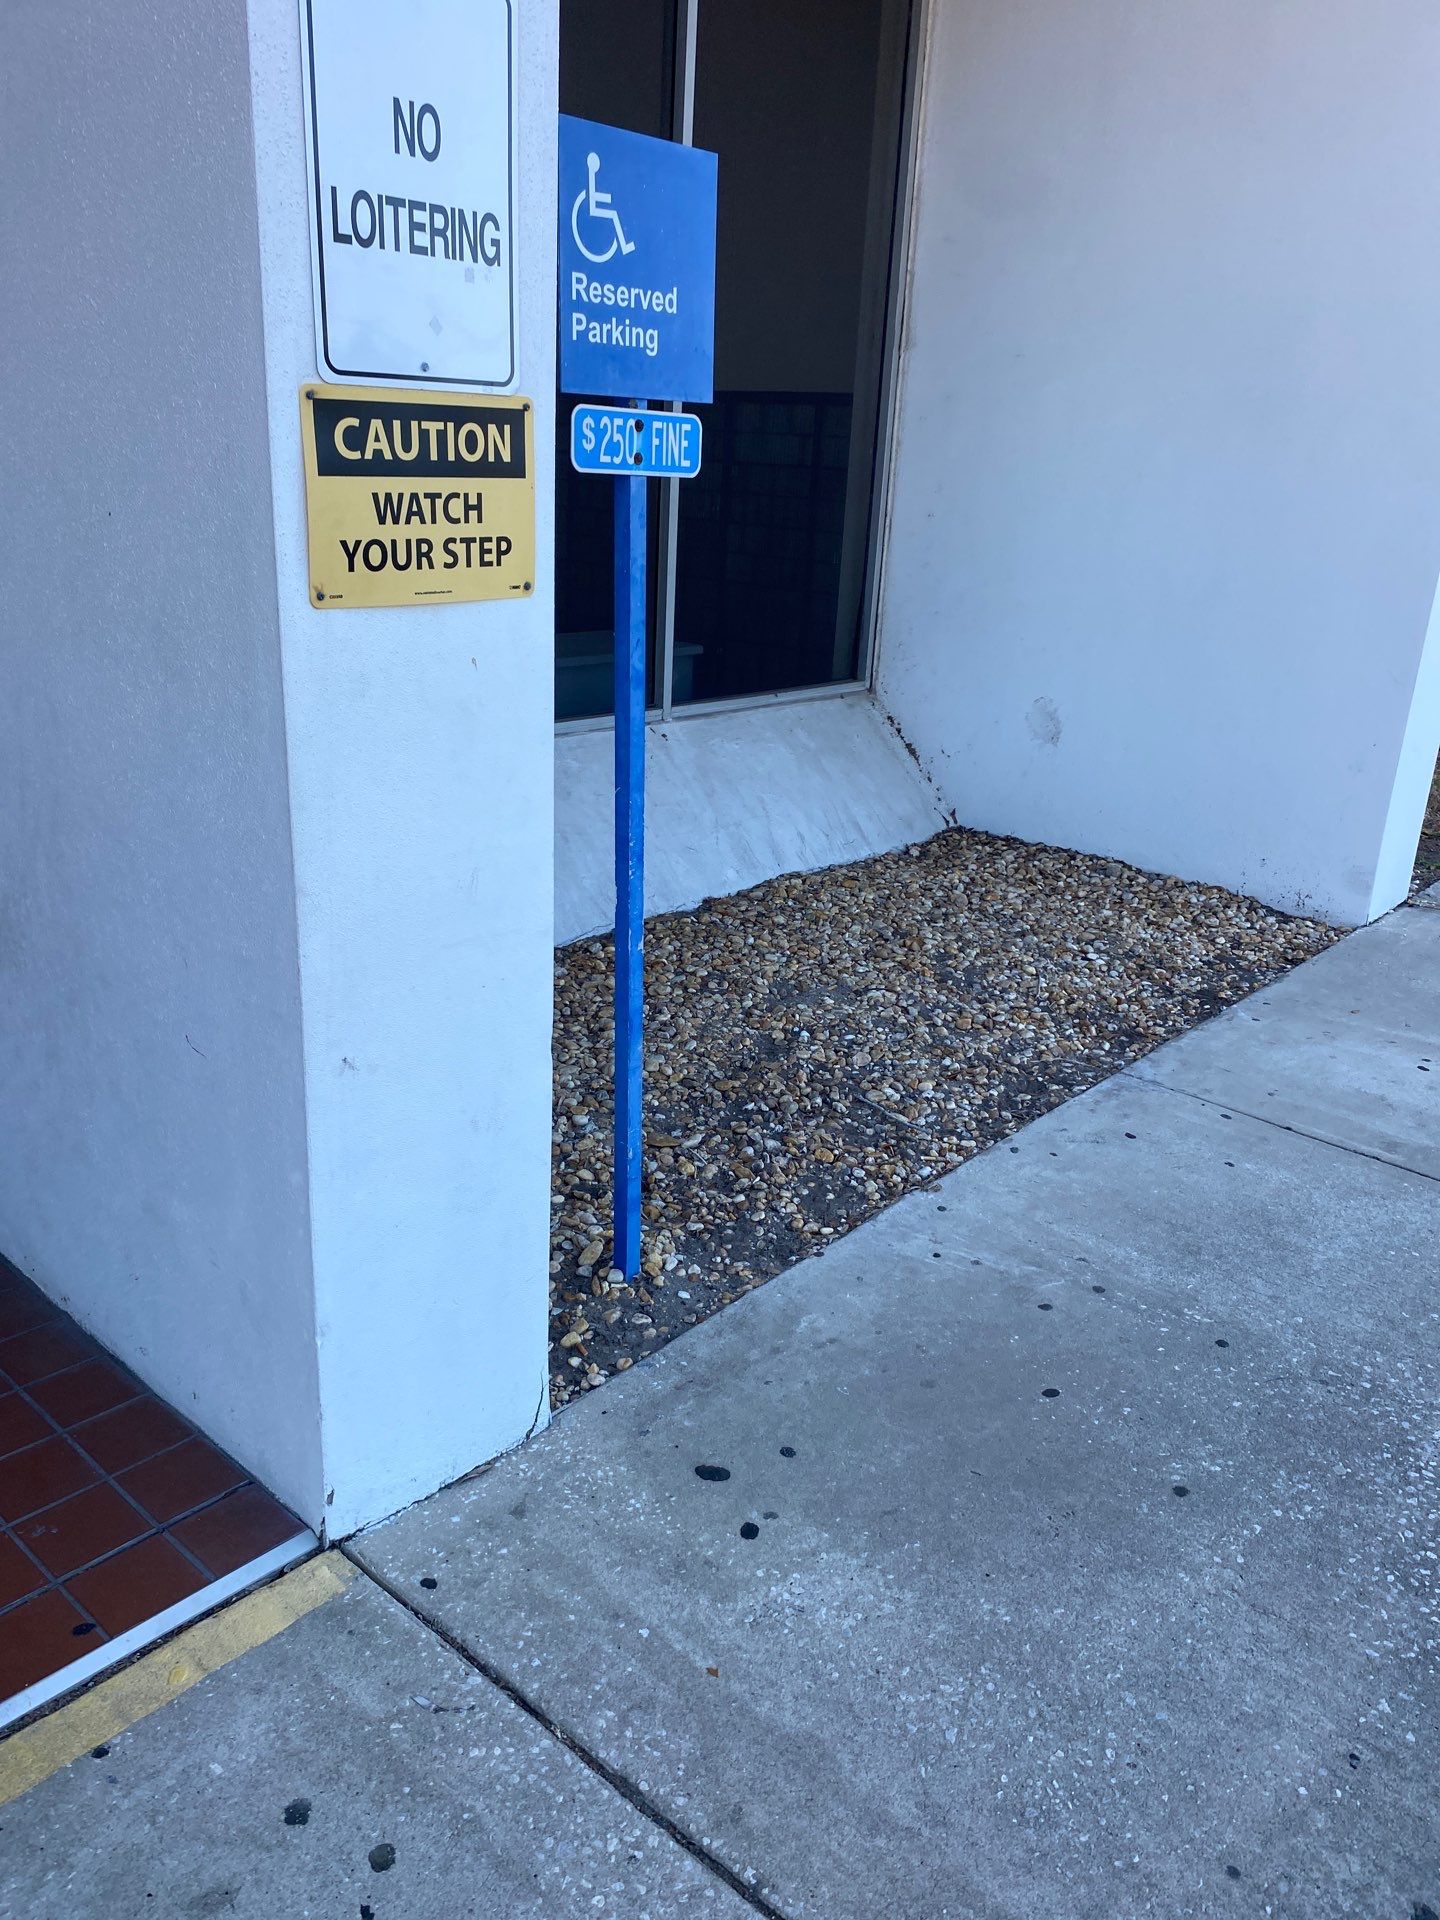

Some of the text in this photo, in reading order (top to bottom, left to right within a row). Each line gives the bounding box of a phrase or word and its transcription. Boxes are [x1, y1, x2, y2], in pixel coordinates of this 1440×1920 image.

[392, 97, 441, 162] NO
[330, 186, 501, 267] LOITERING
[572, 271, 678, 315] Reserved
[572, 314, 658, 356] Parking
[334, 418, 511, 462] CAUTION
[652, 421, 691, 467] FINE
[372, 492, 483, 525] WATCH
[340, 536, 512, 573] YOUR STEP
